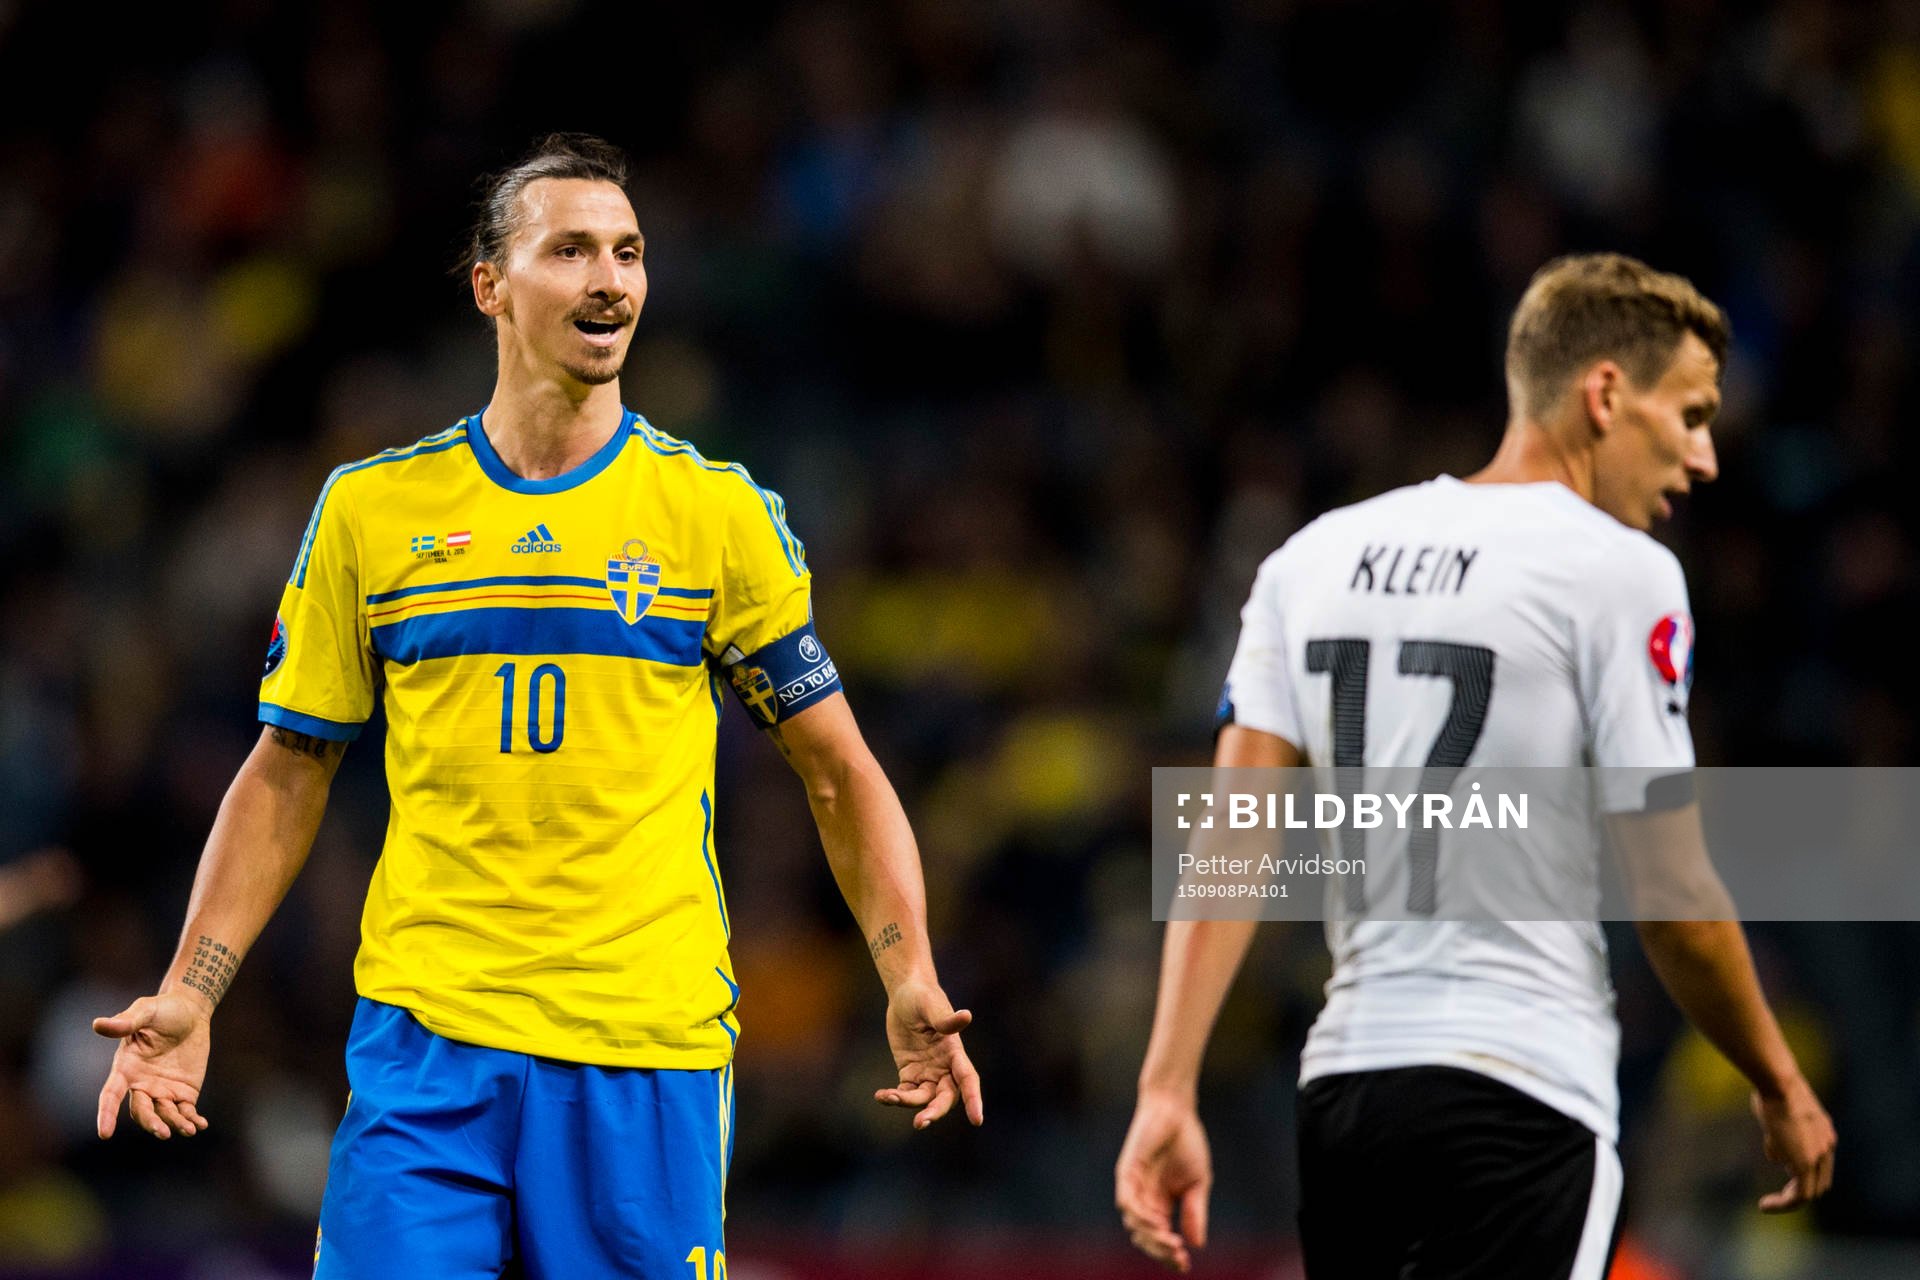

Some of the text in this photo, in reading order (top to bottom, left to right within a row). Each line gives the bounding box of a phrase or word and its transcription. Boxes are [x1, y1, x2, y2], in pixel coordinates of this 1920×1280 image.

[511, 541, 562, 554] adidas
[1351, 545, 1478, 594] KLEIN
[494, 662, 566, 754] 10
[779, 683, 805, 702] NO
[805, 672, 823, 689] TO
[1305, 638, 1494, 914] 17
